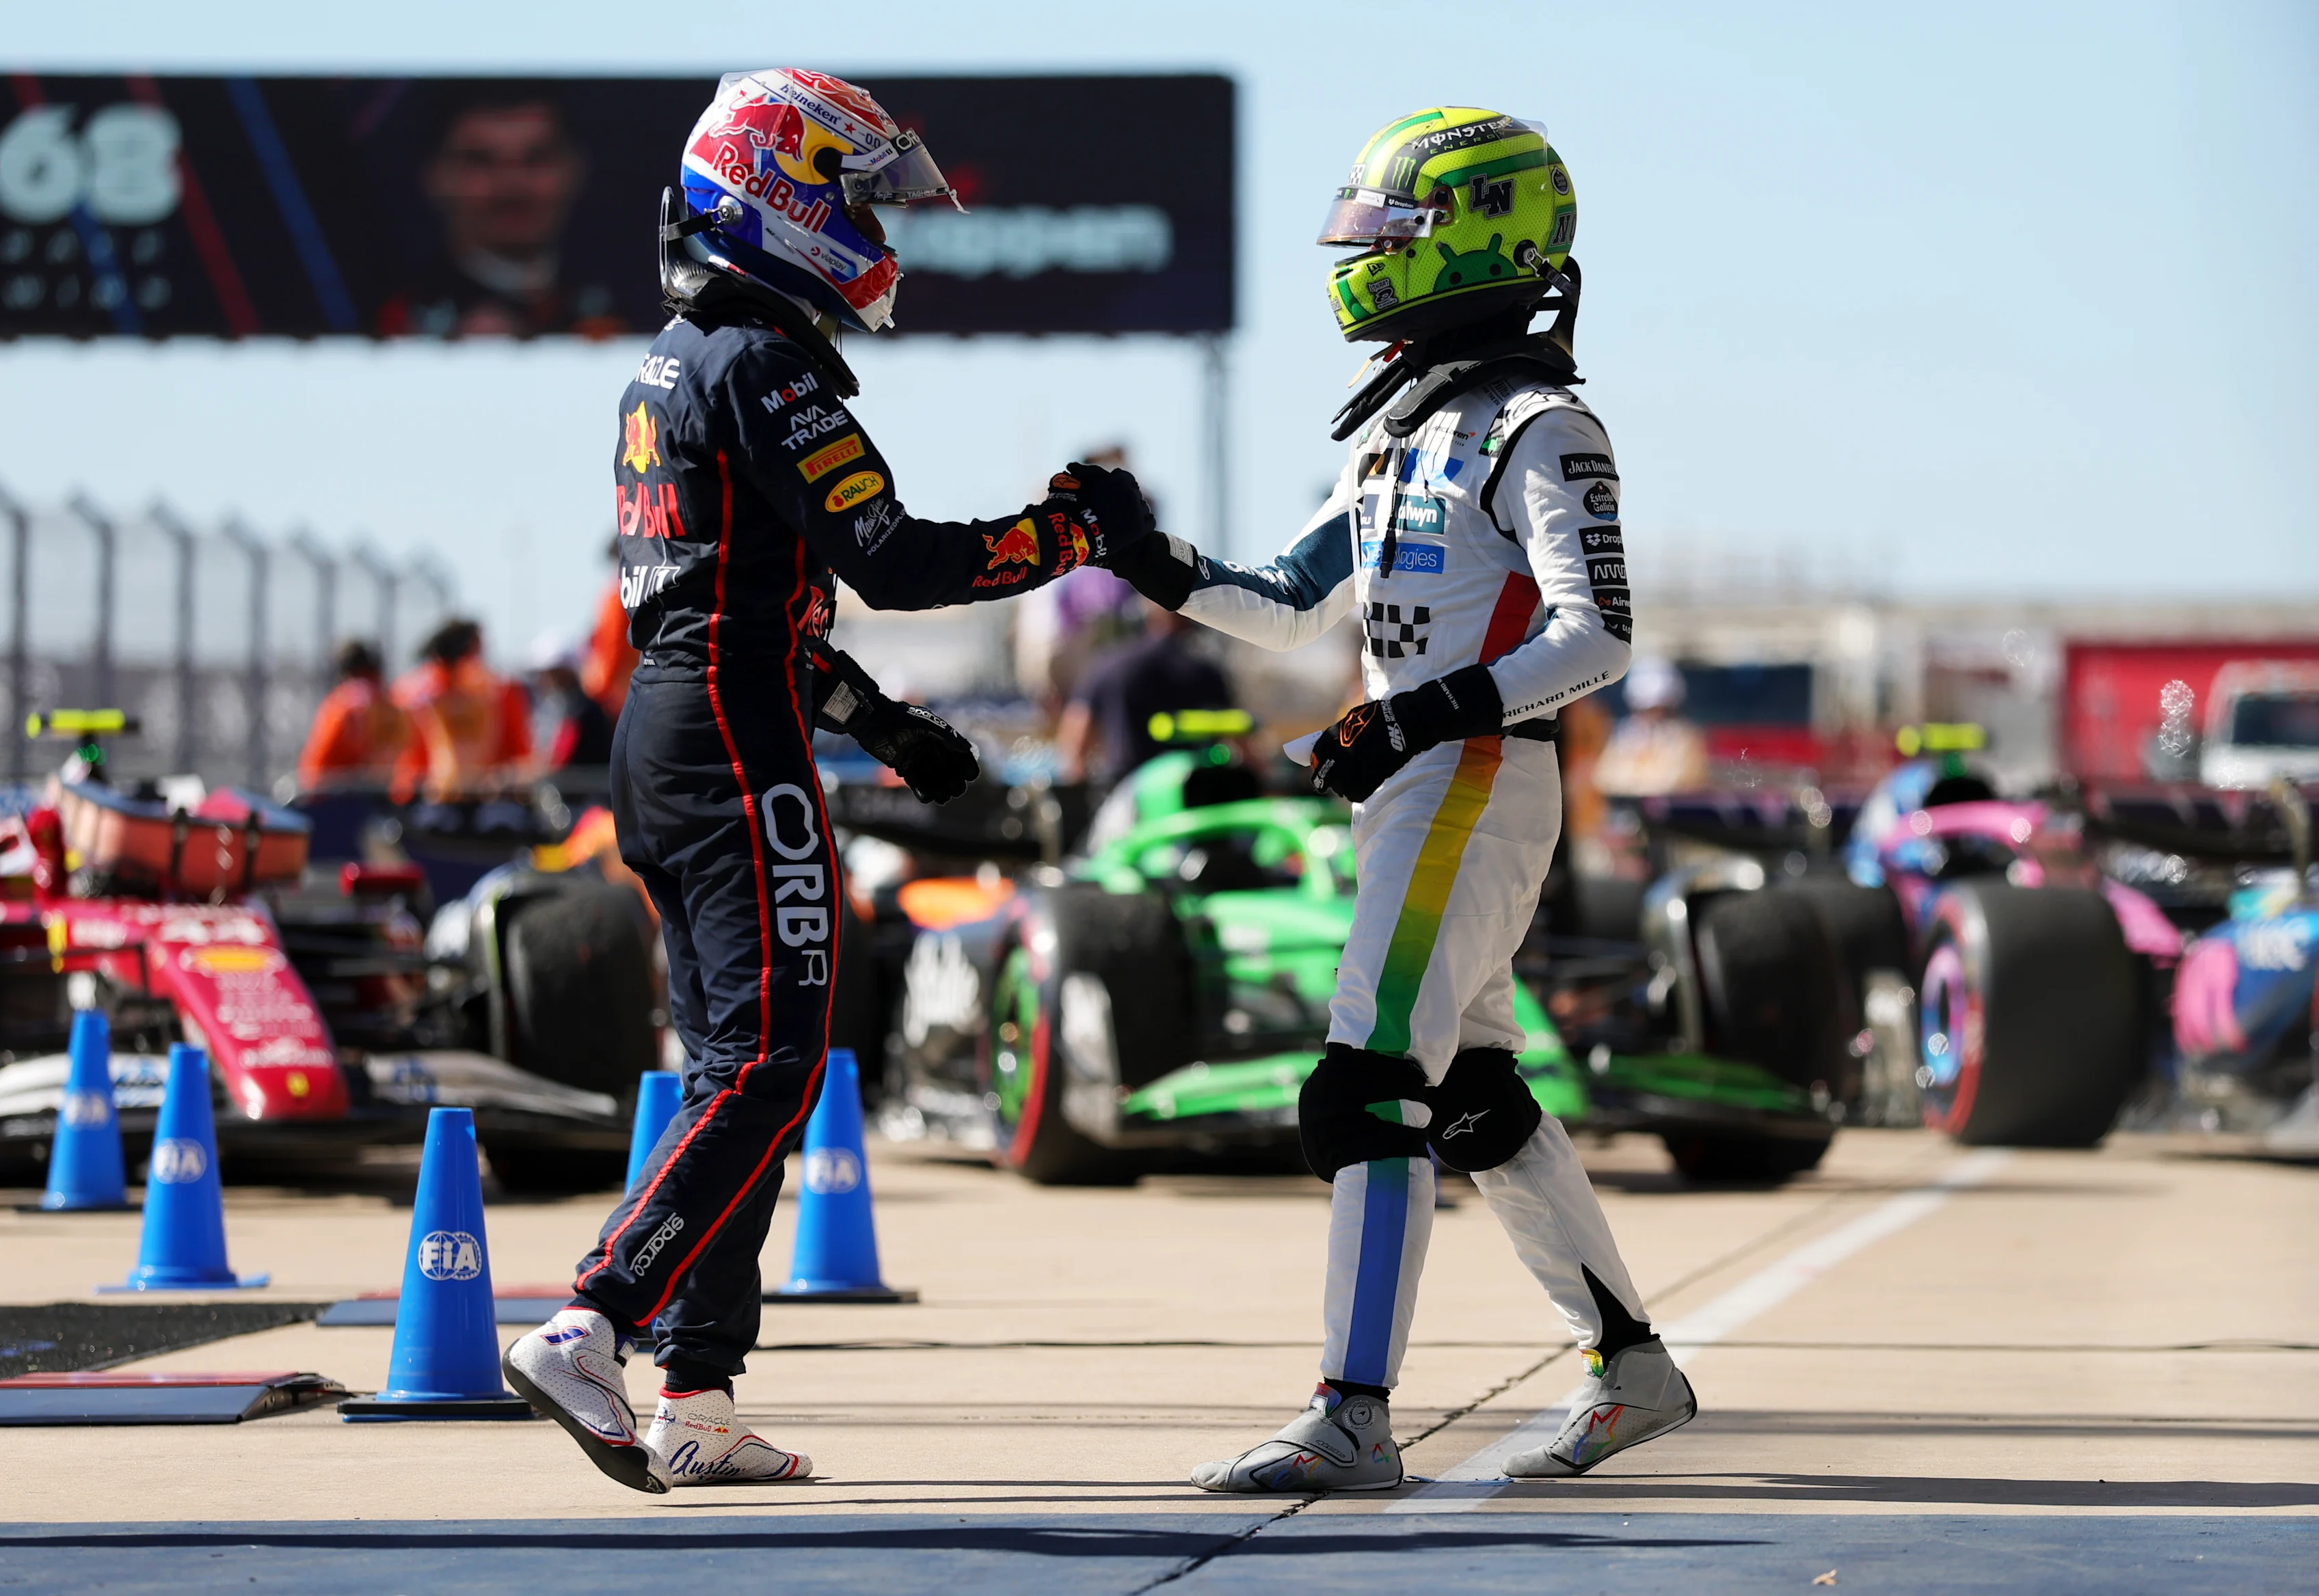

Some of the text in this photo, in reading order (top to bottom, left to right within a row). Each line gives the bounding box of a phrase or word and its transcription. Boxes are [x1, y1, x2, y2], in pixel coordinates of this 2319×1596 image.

[1395, 200, 1415, 209] Dropbox
[820, 254, 847, 271] viaplay
[760, 372, 819, 414] Mobil
[781, 409, 848, 450] TRADE
[790, 405, 827, 432] AVA
[805, 439, 859, 476] PIRELLI
[1568, 461, 1592, 474] JACK
[841, 476, 880, 502] RAUCH
[1590, 492, 1614, 503] Estrella
[1593, 502, 1616, 513] Galicia
[972, 566, 1028, 588] Red Bull
[1440, 683, 1460, 710] RICHARD
[1503, 670, 1611, 719] RICHARD MILLE
[907, 707, 948, 729] sparco
[632, 1215, 684, 1277] sparco
[688, 1413, 731, 1426] ORACLE
[668, 1440, 740, 1477] Austin
